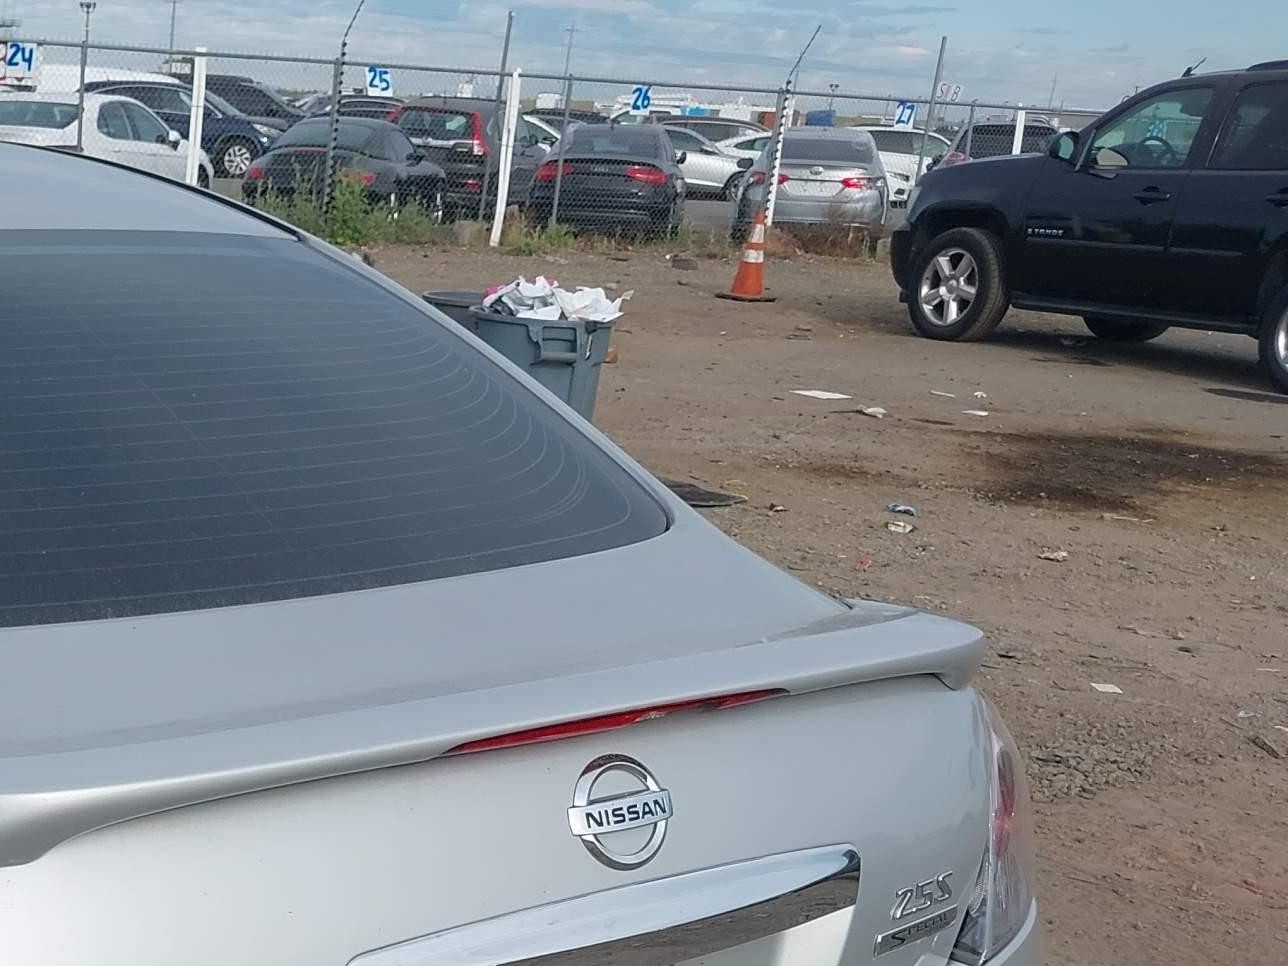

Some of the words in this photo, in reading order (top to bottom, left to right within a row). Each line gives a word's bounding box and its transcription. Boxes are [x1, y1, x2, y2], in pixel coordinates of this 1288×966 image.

[7, 43, 33, 72] 24
[368, 65, 390, 91] 25
[632, 84, 651, 110] 26
[895, 101, 915, 126] 27
[585, 797, 667, 829] NISSAN
